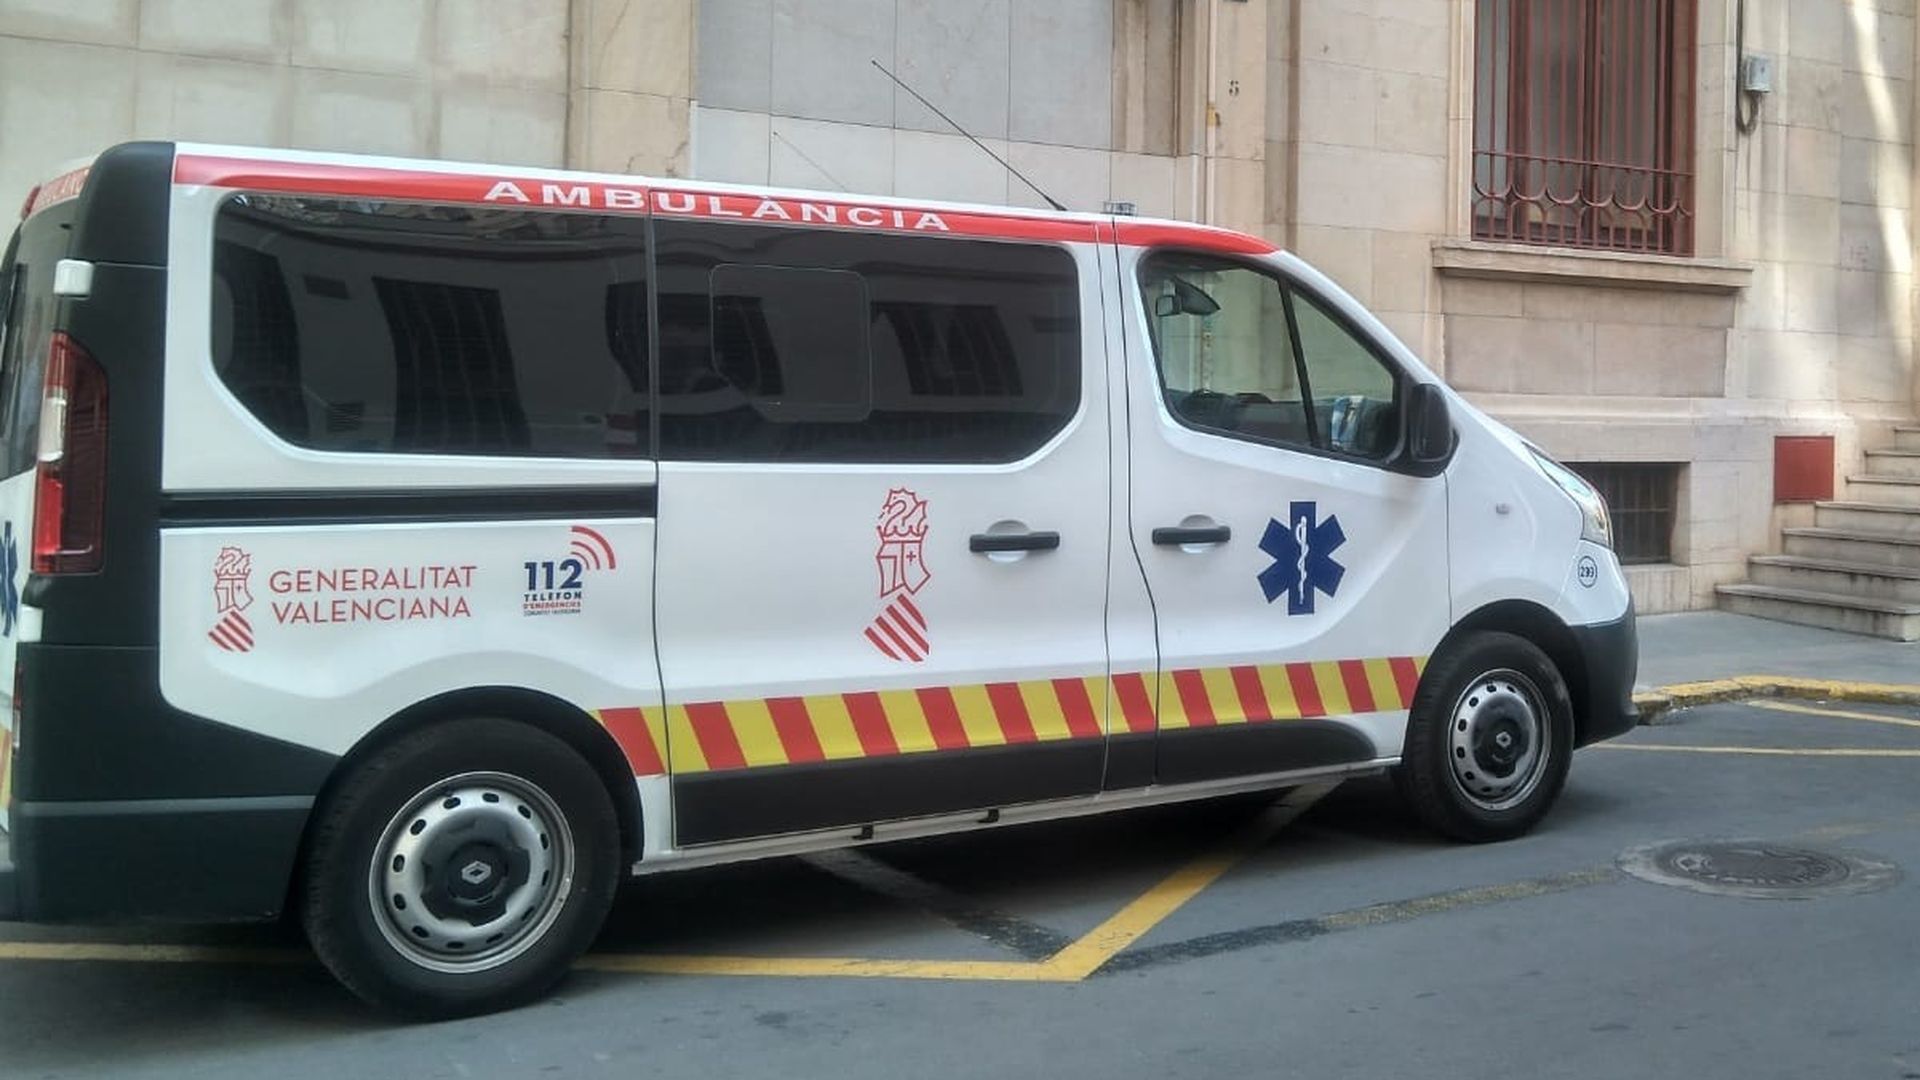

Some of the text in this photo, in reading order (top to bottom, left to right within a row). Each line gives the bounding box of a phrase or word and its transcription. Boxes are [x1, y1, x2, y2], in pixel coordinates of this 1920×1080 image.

[483, 180, 950, 231] AMBULÀNCIA
[269, 565, 477, 594] GENERALITAT
[523, 558, 582, 591] 112
[271, 596, 472, 624] VALENCIANA
